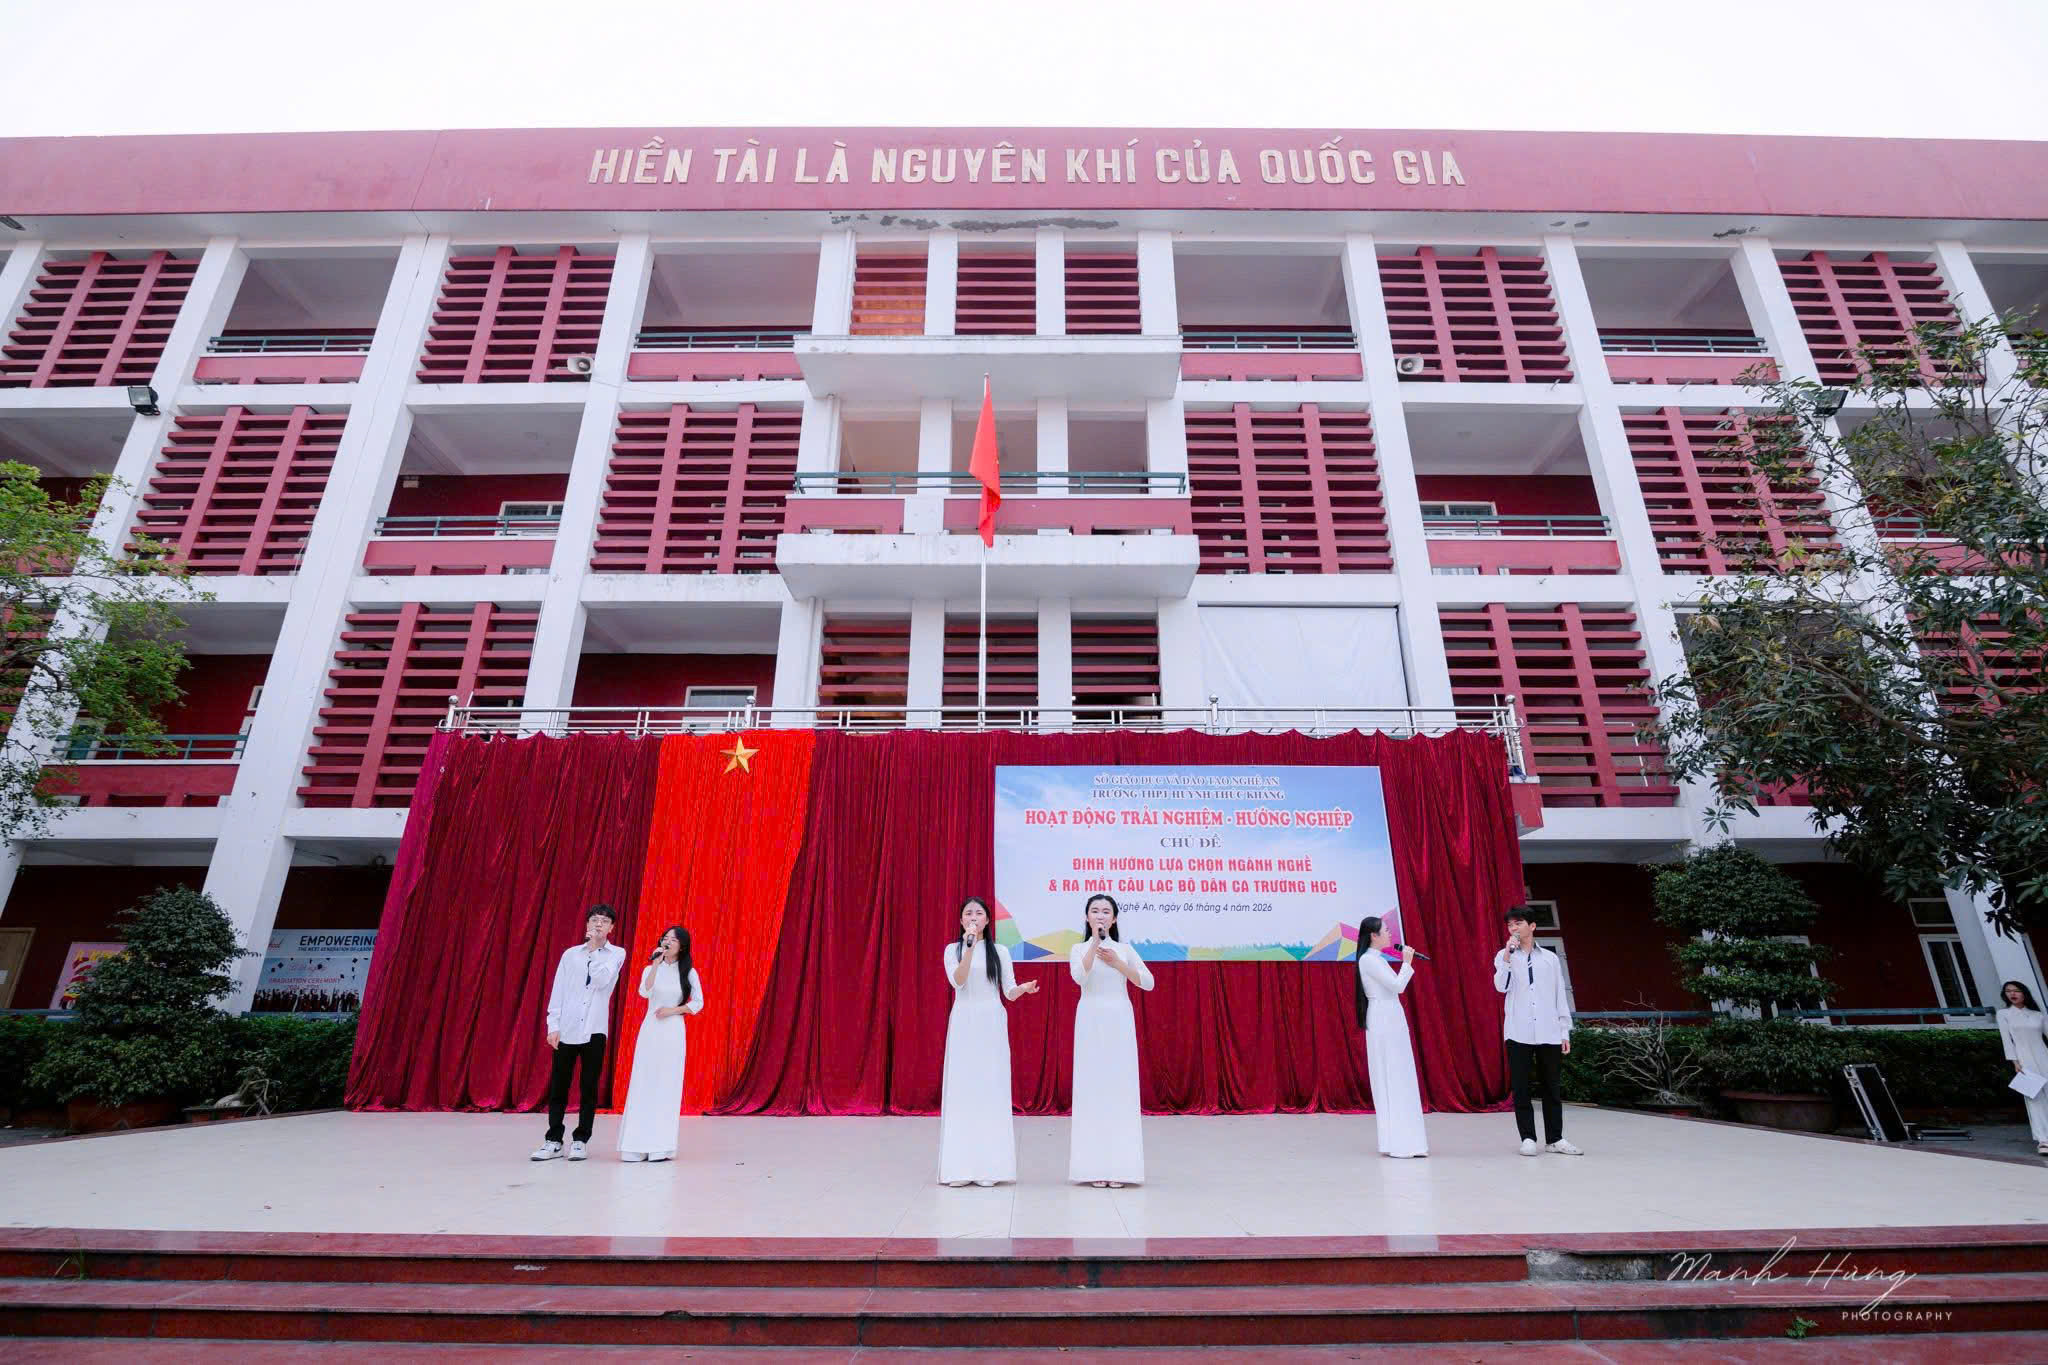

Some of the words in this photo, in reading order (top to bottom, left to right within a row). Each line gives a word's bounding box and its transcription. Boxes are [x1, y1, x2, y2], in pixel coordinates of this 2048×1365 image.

[588, 135, 694, 184] HIỀN
[713, 138, 778, 184] TÀI
[794, 140, 850, 184] LÀ
[871, 142, 1047, 184] NGUYÊN
[1066, 138, 1140, 184] KHÍ
[1155, 138, 1241, 184] CỦA
[1258, 135, 1376, 185] QUỐC
[1392, 149, 1466, 186] GIA
[1264, 776, 1279, 785] AN
[1142, 789, 1168, 799] THPT
[1025, 810, 1068, 828] HOẠT
[1072, 807, 1117, 829] ĐỘNG
[1120, 805, 1158, 825] TRẢI
[1162, 808, 1223, 829] NGHIỆM
[1235, 808, 1291, 826] HƯỚNG
[1295, 808, 1353, 830] NGHIỆP
[1160, 835, 1195, 848] CHỦ
[1200, 833, 1222, 848] ĐỀ
[1072, 858, 1105, 872] ĐỊNH
[1109, 856, 1154, 871] HƯỚNG
[1159, 858, 1183, 873] LỰA
[1188, 858, 1223, 873] CHỌN
[1228, 857, 1273, 871] NGÀNH
[1278, 855, 1312, 872] NGHỀ
[1048, 879, 1057, 892] &
[1063, 880, 1079, 892] RA
[1085, 874, 1113, 892] MẮT
[1118, 877, 1144, 892] CÂU
[1149, 879, 1173, 894] LẠC
[1178, 877, 1196, 895] BỘ
[1201, 878, 1227, 892] DÂN
[1232, 880, 1249, 892] CA
[1254, 878, 1306, 893] TRƯỜNG
[1311, 880, 1337, 895] HỌC
[1142, 903, 1157, 912] An,
[1159, 903, 1181, 913] ngày
[1183, 903, 1193, 911] 06
[1196, 903, 1220, 913] tháng
[1223, 903, 1228, 911] 4
[1230, 903, 1250, 911] năm
[1252, 903, 1272, 911] 2026
